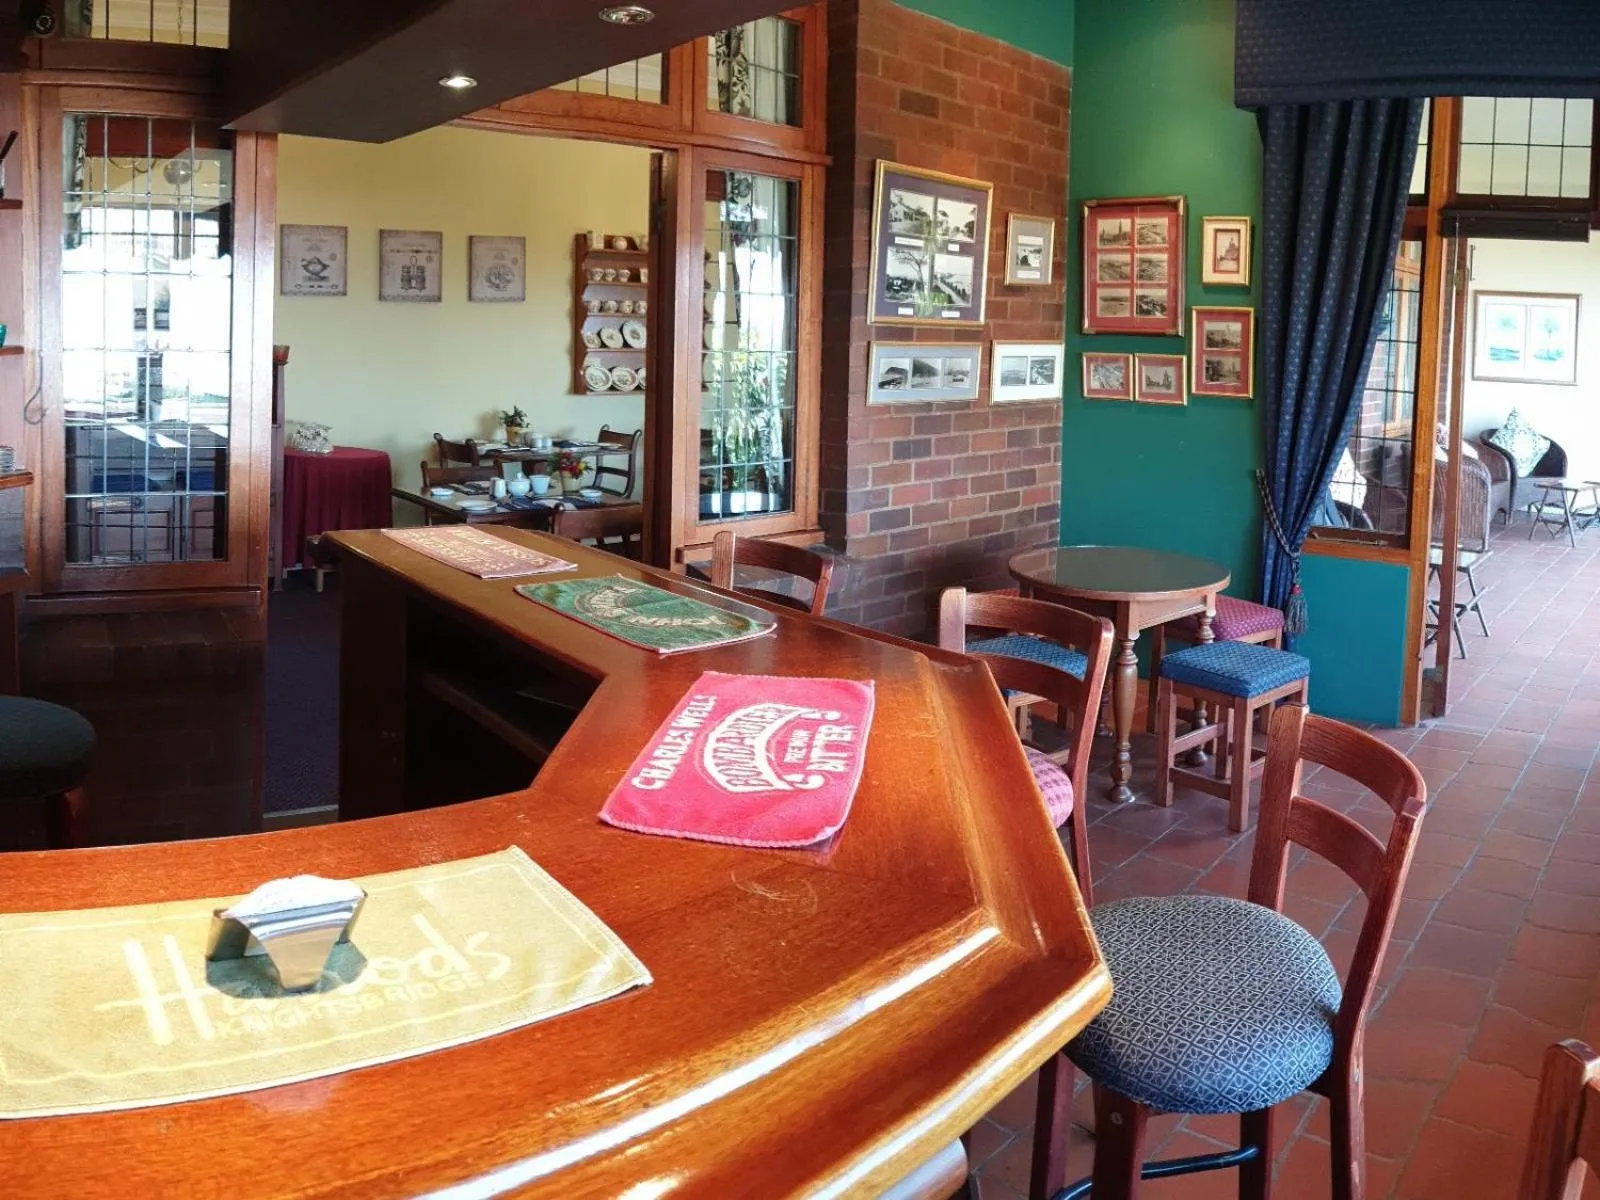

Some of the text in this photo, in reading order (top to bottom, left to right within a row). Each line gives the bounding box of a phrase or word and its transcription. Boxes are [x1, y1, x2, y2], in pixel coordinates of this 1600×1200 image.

[631, 694, 718, 790] CHARLES WELLS
[711, 704, 800, 788] BOMBARDIER
[805, 724, 855, 774] BITTER
